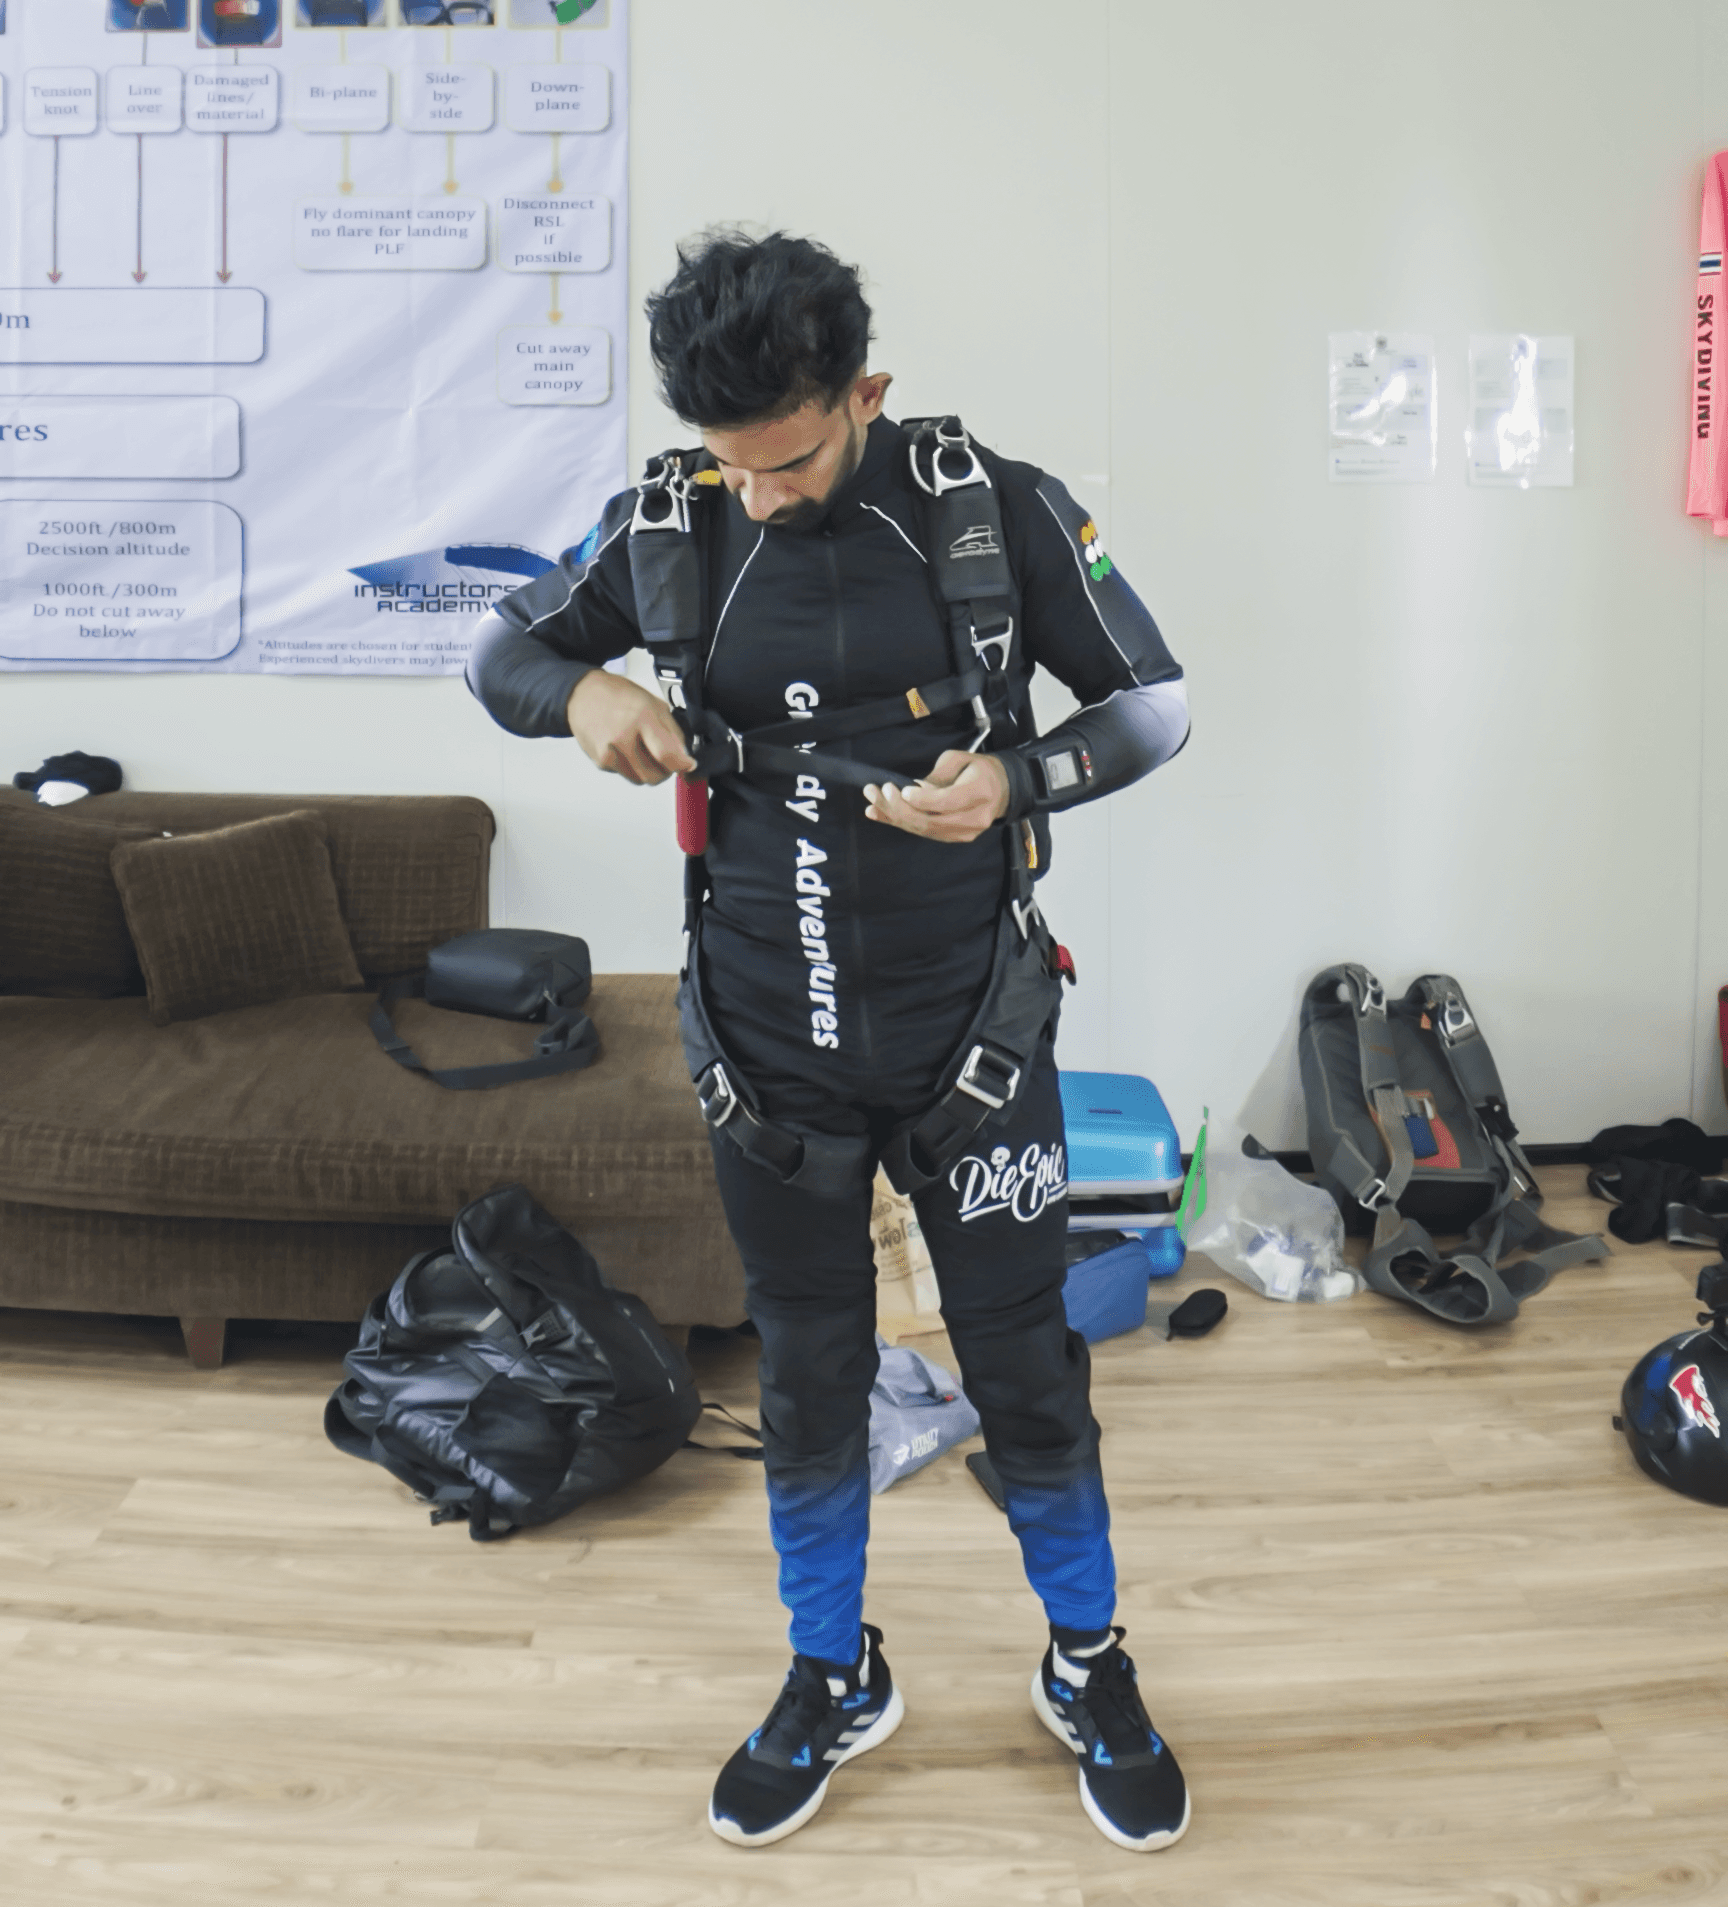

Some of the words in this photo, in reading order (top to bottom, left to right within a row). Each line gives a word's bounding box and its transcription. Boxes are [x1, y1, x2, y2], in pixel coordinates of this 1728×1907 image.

[194, 73, 269, 88] Damaged
[425, 72, 464, 84] Side-
[30, 86, 92, 98] Tension
[128, 84, 162, 96] Line
[309, 86, 377, 101] Bi-plane
[530, 81, 585, 93] Down-
[207, 92, 254, 103] lines/
[432, 90, 459, 104] by-
[44, 105, 78, 115] knot
[126, 104, 163, 114] over
[535, 98, 581, 112] plane
[196, 110, 264, 120] material
[430, 107, 463, 119] side
[503, 197, 594, 210] Disconnect
[303, 207, 328, 221] Fly
[332, 208, 413, 220] dominant
[416, 210, 476, 222] canopy
[534, 215, 560, 227] RSL
[311, 228, 331, 237] no
[336, 225, 374, 238] flare
[378, 225, 402, 237] for
[407, 224, 468, 239] landing
[544, 233, 555, 245] if
[374, 243, 401, 255] PLF
[514, 250, 583, 266] possible
[516, 342, 543, 354] Cut
[549, 345, 591, 357] away
[534, 363, 574, 372] main
[1697, 294, 1713, 439] SKYDIVING
[524, 380, 584, 392] canopy
[39, 521, 102, 535] 2500ft
[26, 542, 109, 556] Decision
[115, 542, 191, 556] altitude
[42, 583, 105, 597] 1000ft
[33, 603, 59, 617] Do
[65, 606, 95, 617] not
[101, 606, 131, 618] cut
[136, 608, 186, 621] away
[79, 624, 137, 638] below
[325, 641, 349, 652] are
[350, 640, 397, 651] chosen
[400, 639, 420, 652] for
[257, 653, 339, 665] Experienced
[341, 654, 406, 665] skydivers
[409, 657, 438, 668] may
